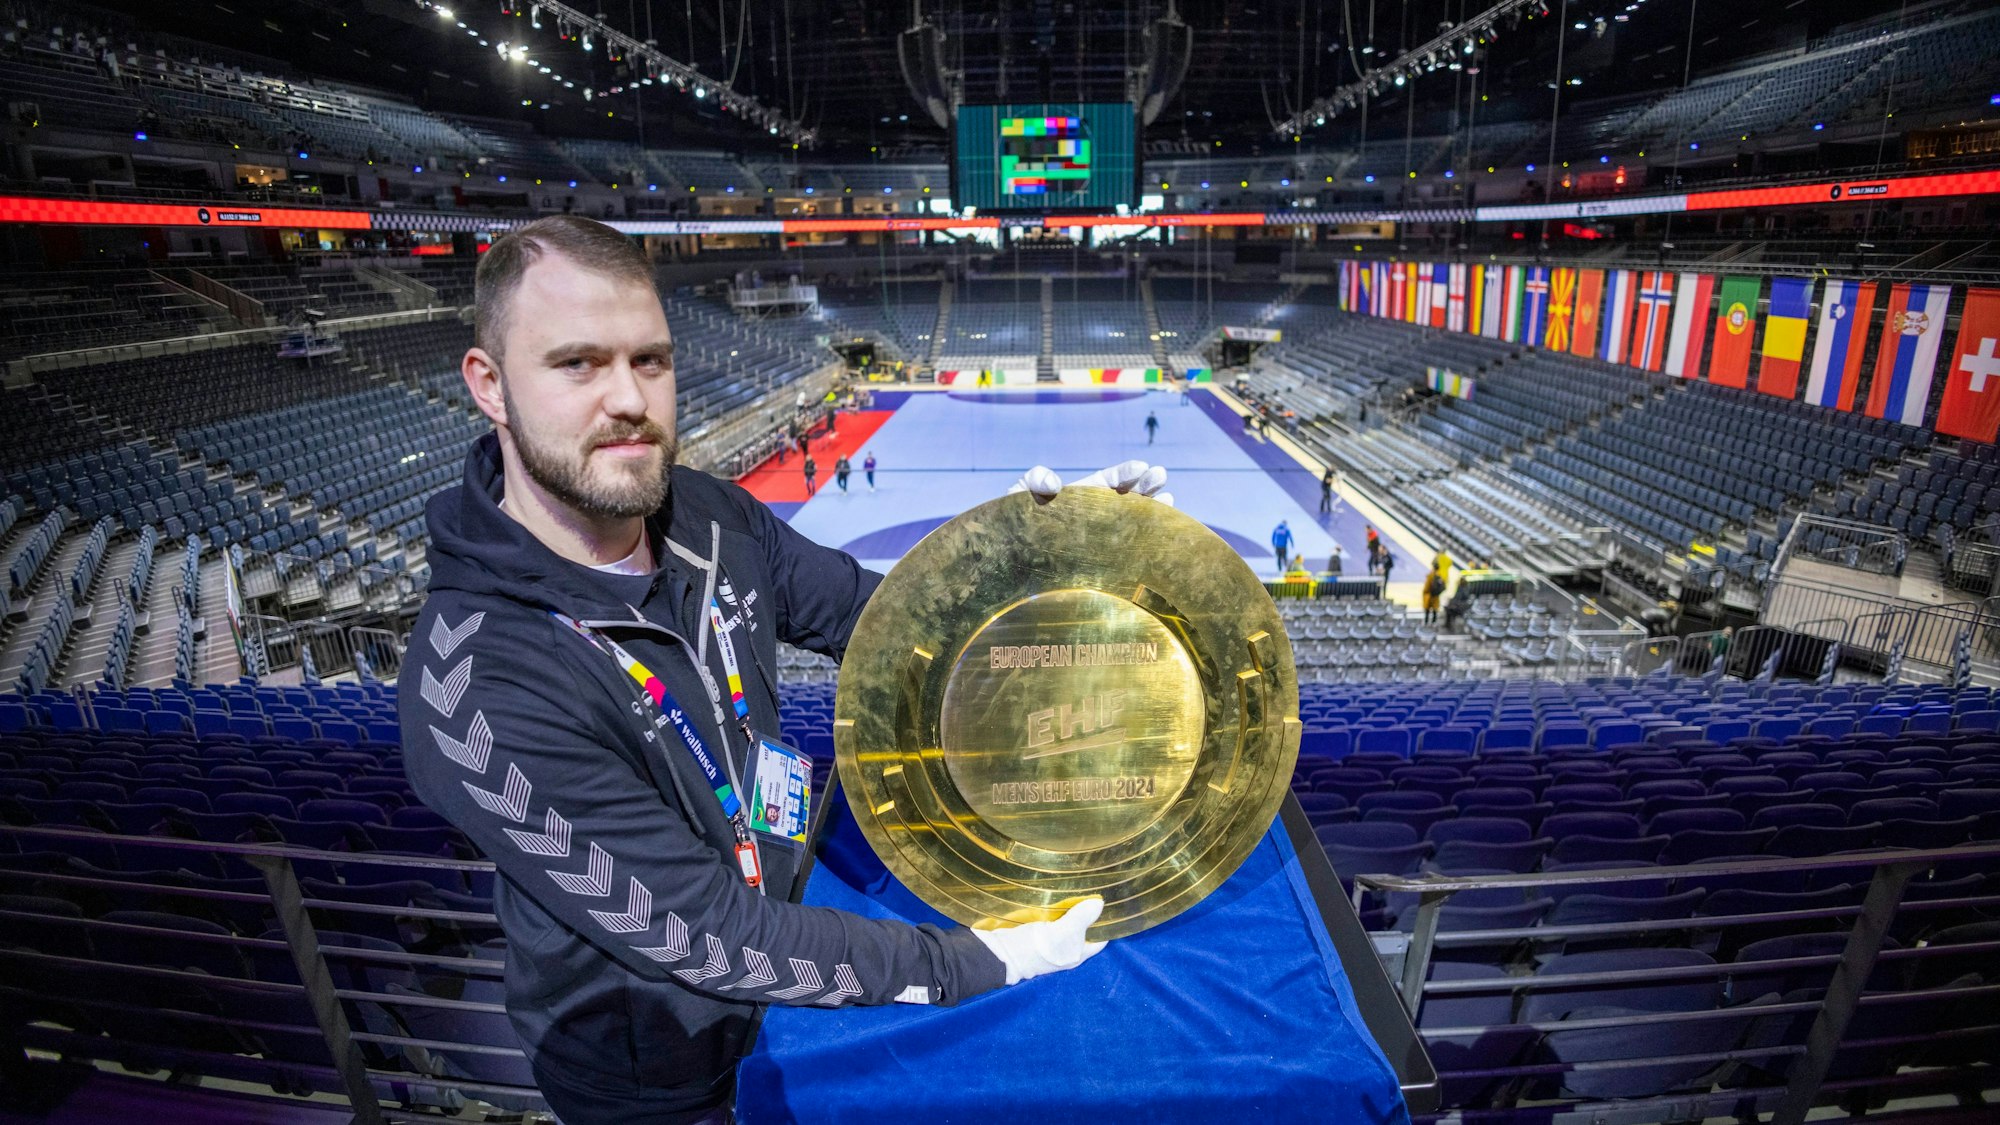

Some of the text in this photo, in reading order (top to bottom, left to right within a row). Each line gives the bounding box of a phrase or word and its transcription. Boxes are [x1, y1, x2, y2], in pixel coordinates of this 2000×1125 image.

[990, 642, 1158, 668] EUROPEAN CHAMPION
[1027, 688, 1128, 748] EHF
[682, 724, 717, 780] walbusch
[992, 776, 1157, 804] MEN'S EHF EURO 2024
